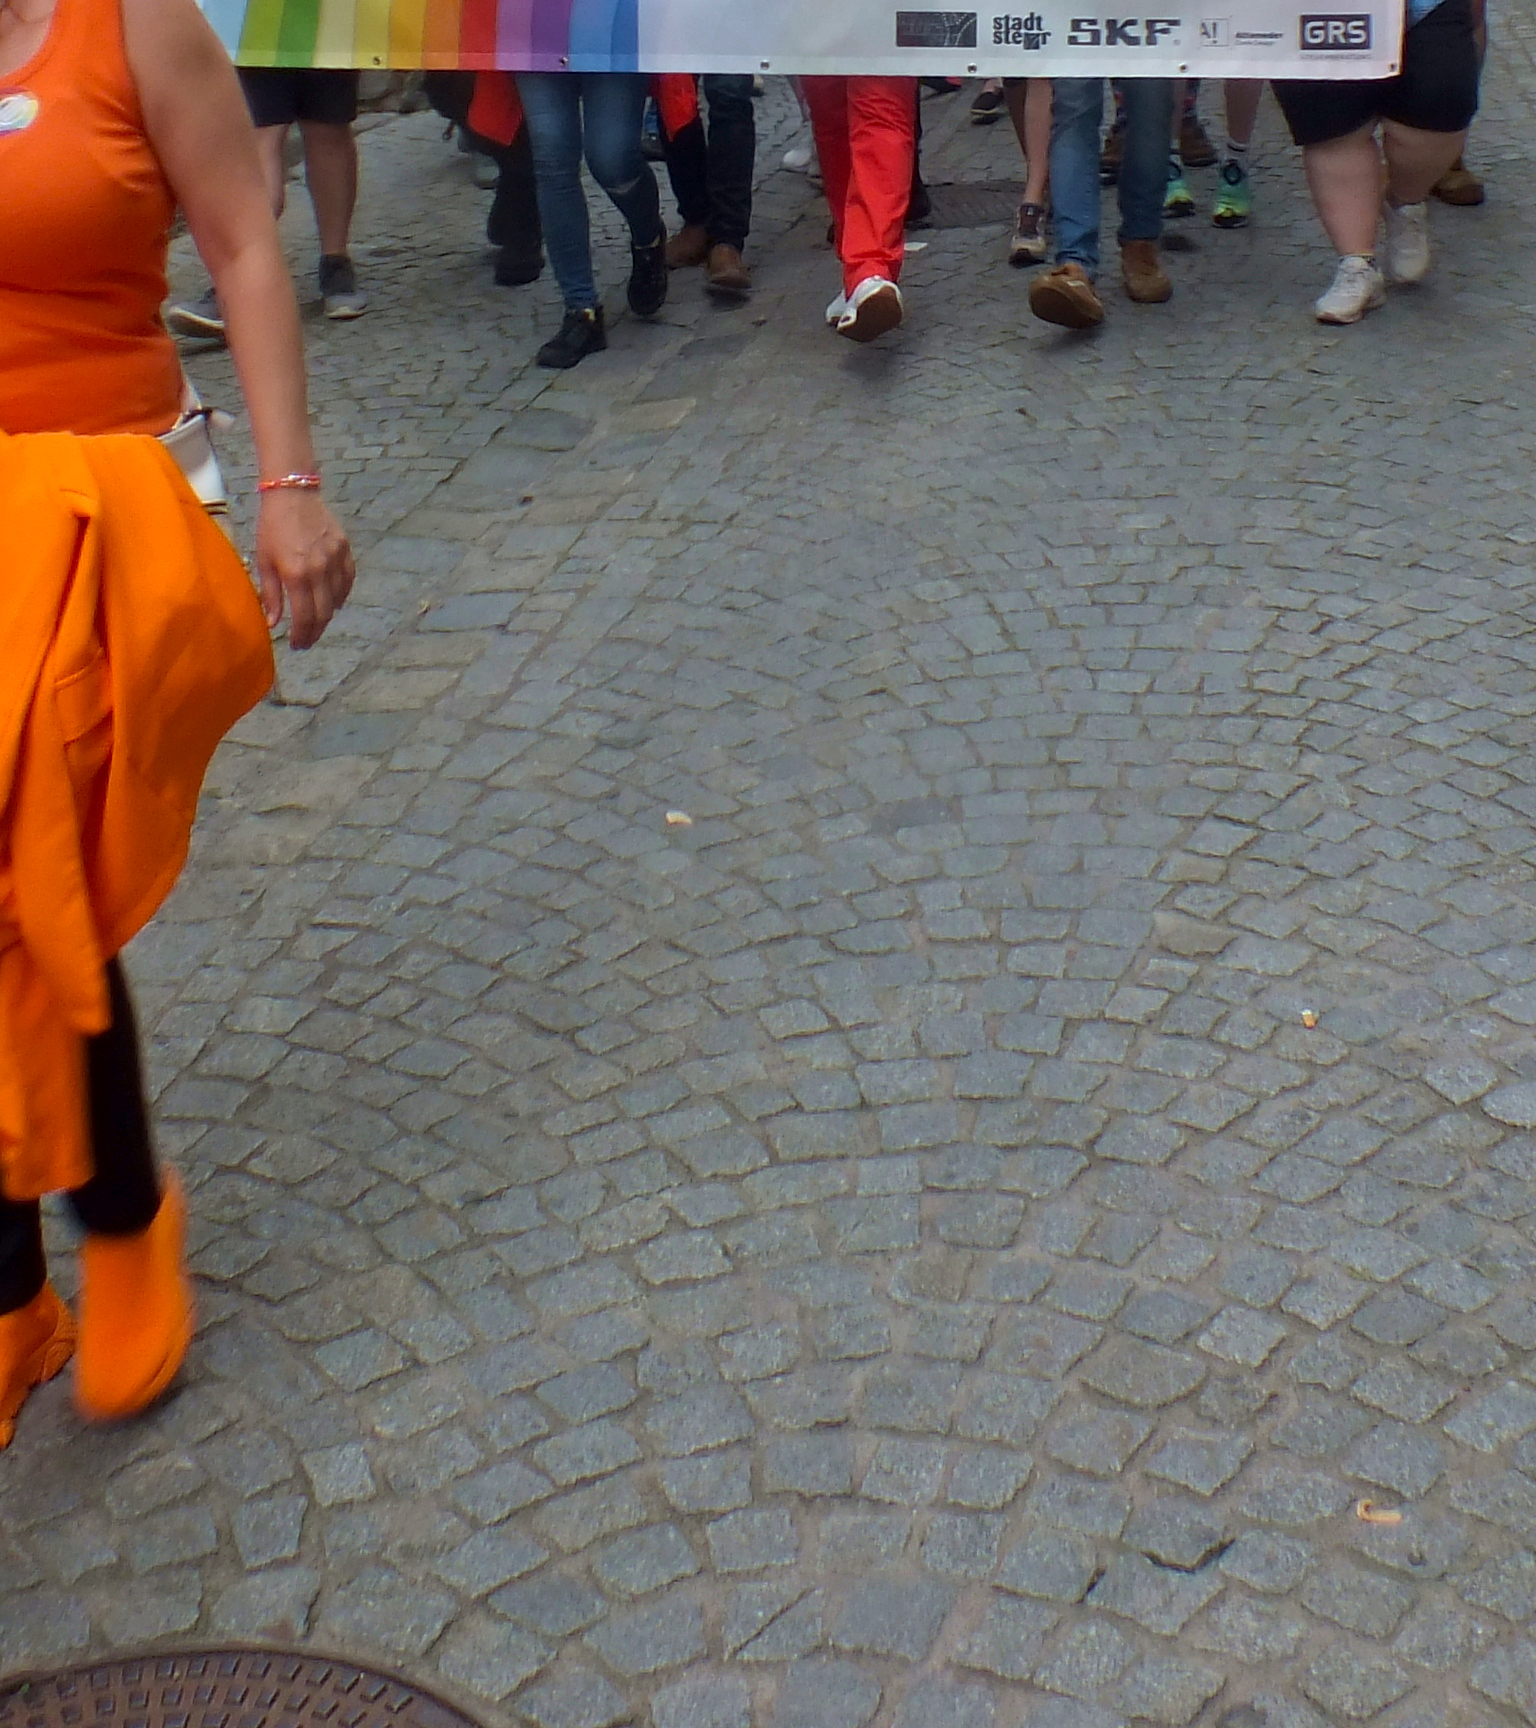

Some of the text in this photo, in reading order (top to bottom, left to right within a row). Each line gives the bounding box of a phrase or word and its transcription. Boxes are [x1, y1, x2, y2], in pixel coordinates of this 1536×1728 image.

[992, 12, 1044, 31] stadt
[1067, 18, 1181, 46] SKF
[1304, 20, 1367, 44] GRS
